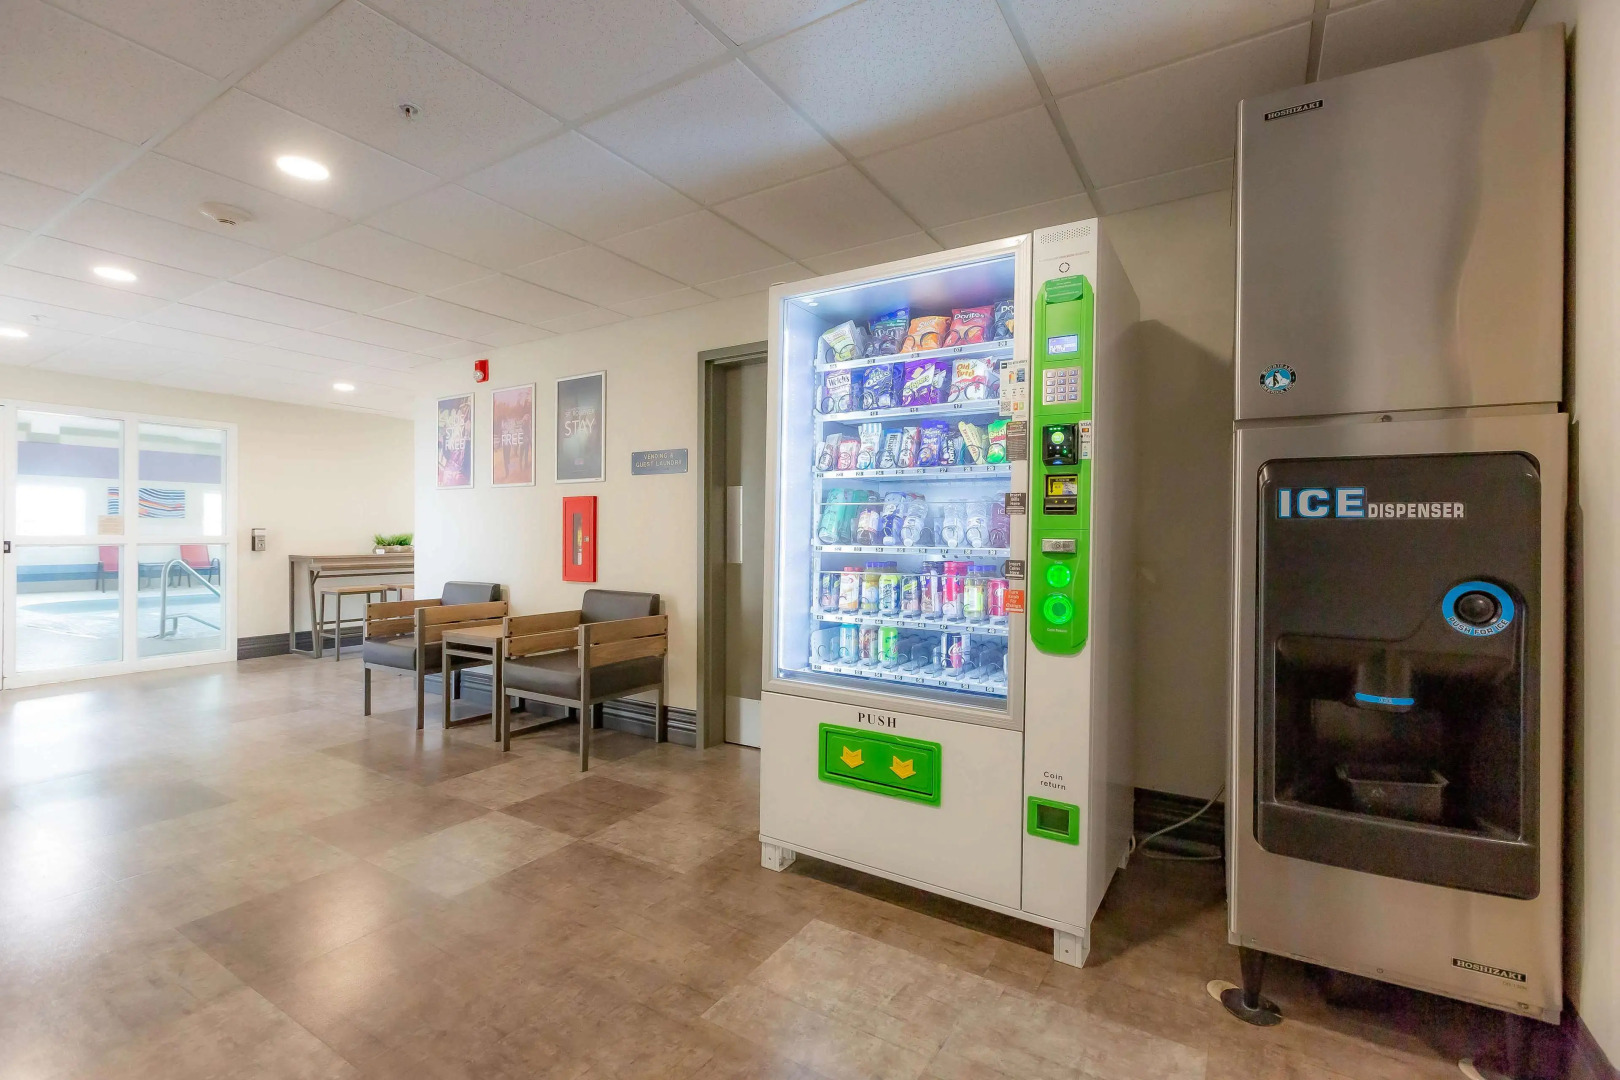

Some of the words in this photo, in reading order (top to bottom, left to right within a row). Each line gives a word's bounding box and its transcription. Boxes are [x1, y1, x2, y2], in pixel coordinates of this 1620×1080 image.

[1267, 101, 1320, 119] HOSHIZAKI
[954, 311, 985, 321] Doritos
[956, 363, 970, 372] Old
[828, 375, 850, 387] Welch's
[446, 426, 465, 439] STAY
[564, 418, 595, 436] STAY
[445, 438, 466, 451] FREE
[501, 432, 524, 447] FREE
[643, 452, 668, 460] VENDING
[655, 459, 682, 467] LAUNDRY
[1278, 487, 1365, 519] ICE
[1367, 503, 1464, 518] DISPENSER
[1448, 616, 1471, 634] PUSH
[1474, 627, 1494, 635] FOR
[1494, 619, 1509, 631] ICE
[858, 712, 896, 728] PUSH
[1043, 771, 1063, 780] Coin
[1040, 780, 1066, 790] return
[1456, 960, 1522, 980] HOSHIZAKI
